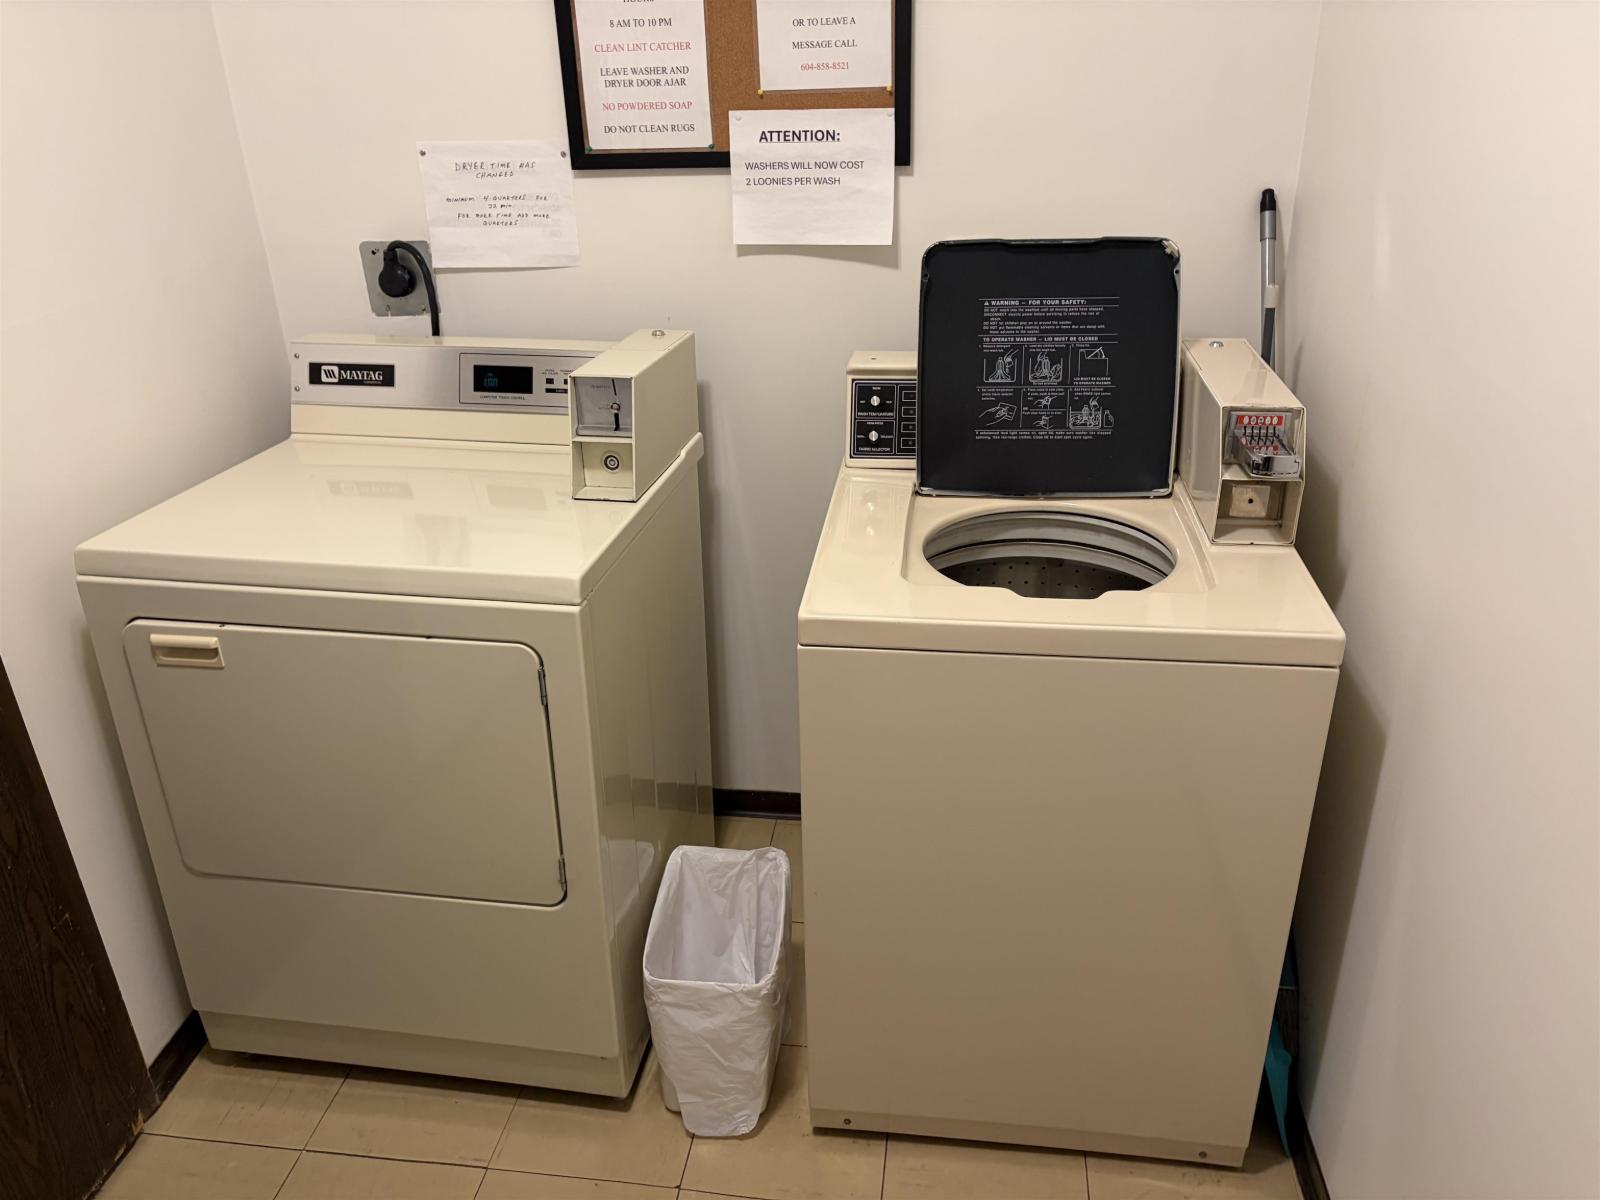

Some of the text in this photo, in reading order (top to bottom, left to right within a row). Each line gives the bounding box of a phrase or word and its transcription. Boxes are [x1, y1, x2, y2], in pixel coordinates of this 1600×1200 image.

[609, 17, 672, 28] 8 AM TO 10 PM
[792, 16, 856, 27] OR TO LEAVE A
[594, 41, 692, 53] CLEAN LINT CATCHER
[792, 39, 858, 50] MESSAGE CALL
[600, 65, 690, 77] LEAVE WASHER AND
[604, 77, 687, 88] DRYER DOOR AJAR
[602, 100, 693, 112] NO POWDERED SOAP
[603, 123, 696, 134] DO NOT CLEAN RUGS
[759, 129, 841, 144] ATTENTION:
[454, 160, 537, 172] DRYER TIME HAS
[744, 160, 865, 172] WASHERS WILL NOW COST
[475, 170, 515, 180] CHANGED
[745, 176, 841, 187] 2 LOONIES PER WASH
[340, 369, 384, 381] MAYTAG
